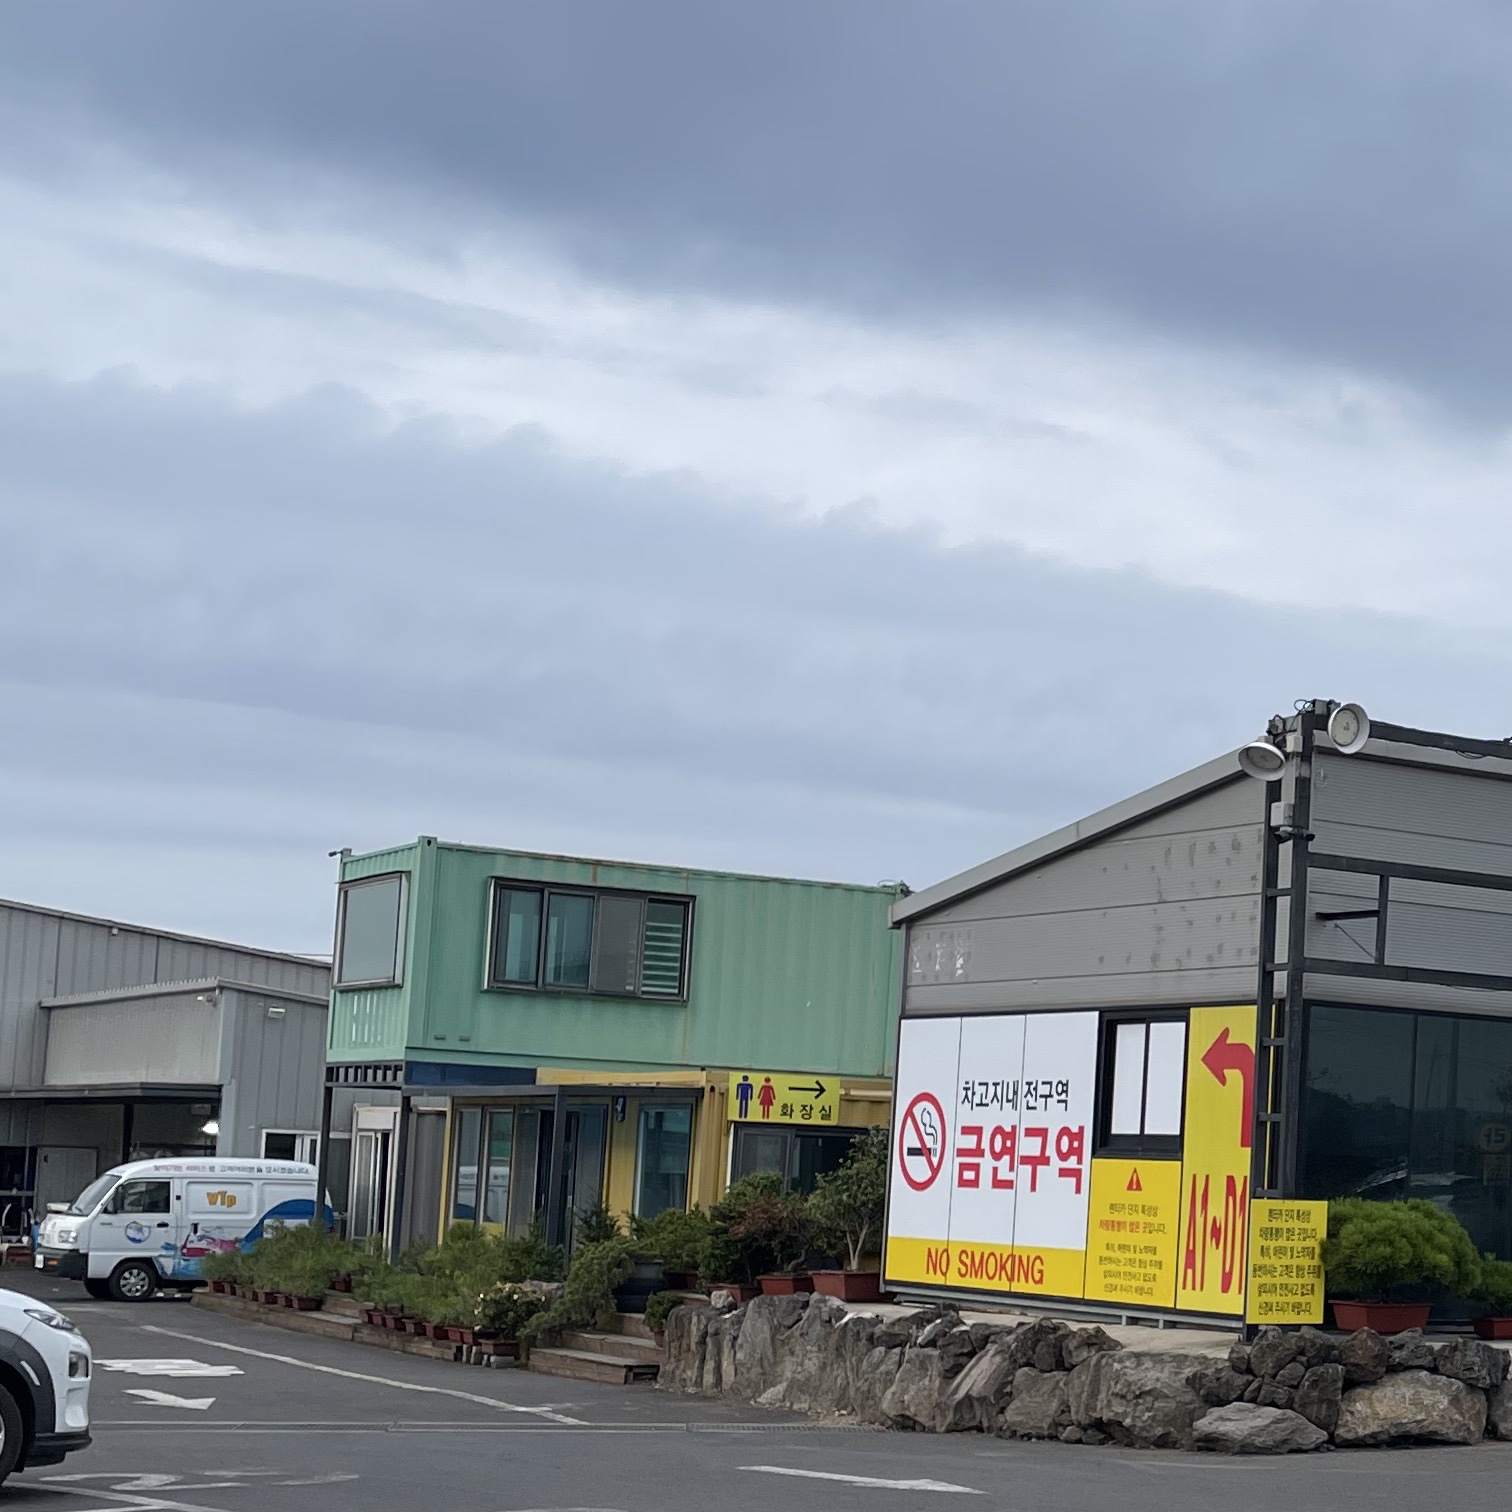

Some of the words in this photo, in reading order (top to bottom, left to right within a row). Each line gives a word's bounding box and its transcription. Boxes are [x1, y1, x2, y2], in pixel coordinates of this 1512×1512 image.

[780, 1103, 832, 1121] 화장실
[961, 1080, 1019, 1112] 차고지내
[1024, 1079, 1069, 1112] 전구역
[956, 1124, 1085, 1195] 금연구역
[1182, 1173, 1248, 1295] A1~D1
[926, 1247, 950, 1278] NO
[957, 1249, 1044, 1285] SMOKING
